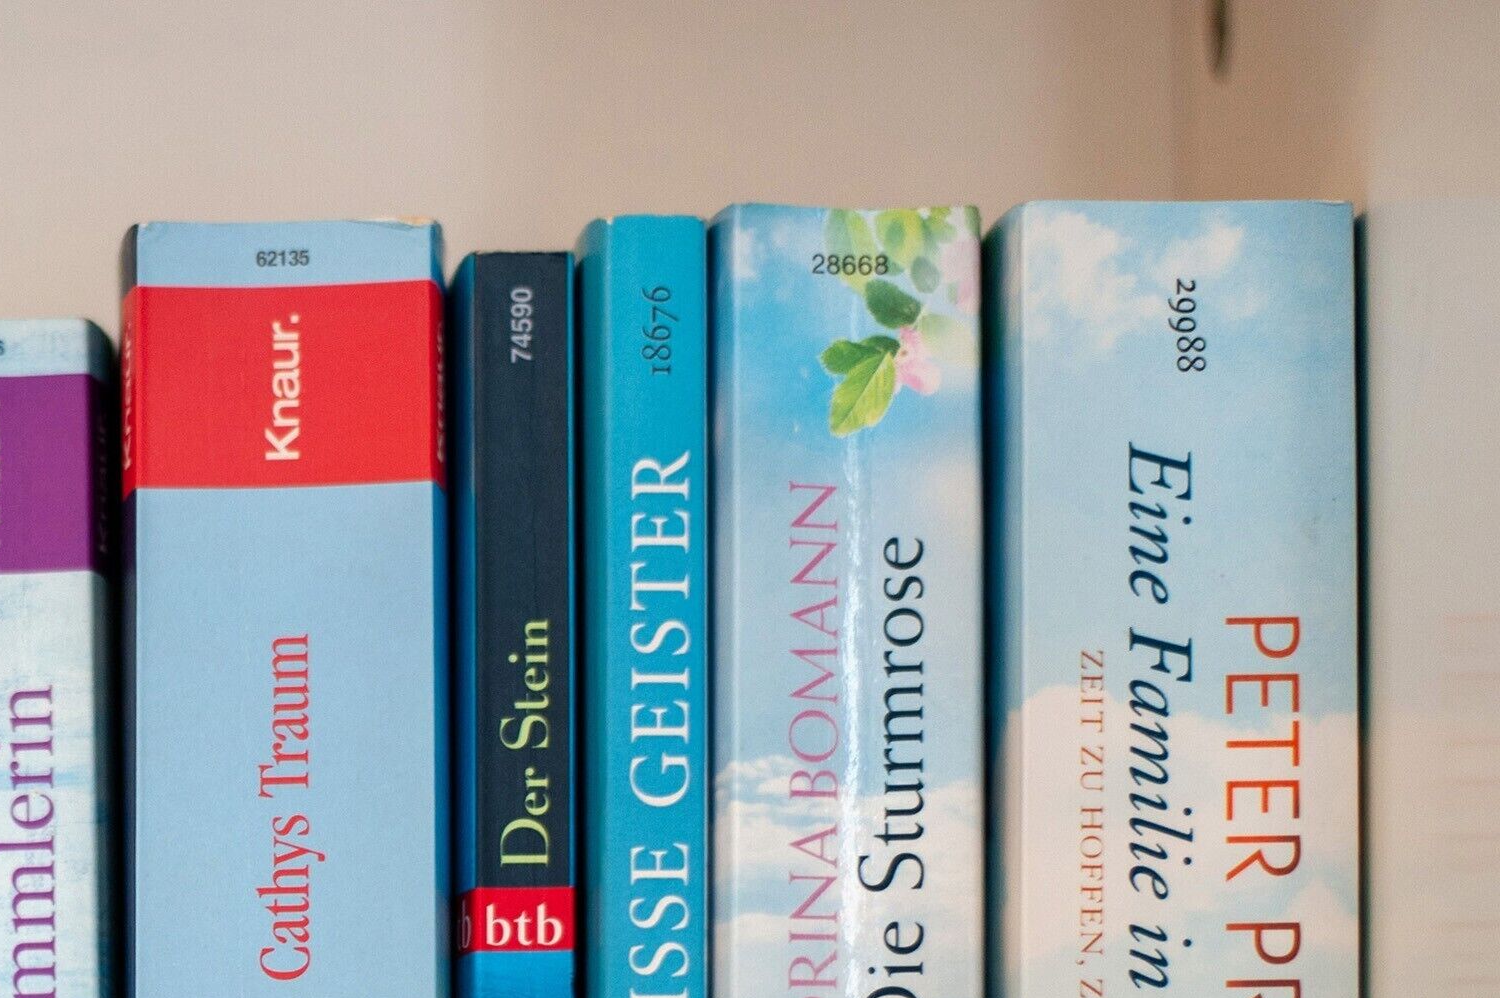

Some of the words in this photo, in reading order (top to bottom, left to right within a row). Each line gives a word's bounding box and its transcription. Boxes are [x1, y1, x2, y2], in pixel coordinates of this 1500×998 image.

[255, 249, 311, 268] 62135
[812, 253, 890, 276] 28668
[264, 312, 301, 463] Knaur.
[510, 286, 533, 364] 74590
[641, 285, 680, 375] 18676
[1168, 278, 1207, 373] 29988
[1127, 441, 1193, 605] Eine
[500, 618, 550, 749] Stein
[629, 450, 693, 807] GEISTER
[788, 479, 841, 800] BOMANN
[1079, 650, 1105, 734] ZEIT
[257, 633, 310, 798] Traum
[857, 535, 926, 893] Sturmrose
[1079, 739, 1105, 793] ZU
[1128, 626, 1195, 901] Familie
[1224, 615, 1302, 882] PETER
[500, 767, 551, 867] Der
[255, 814, 326, 982] Cathys
[484, 903, 565, 947] btb
[1076, 806, 1105, 966] HOFFEN,
[1127, 924, 1194, 990] in
